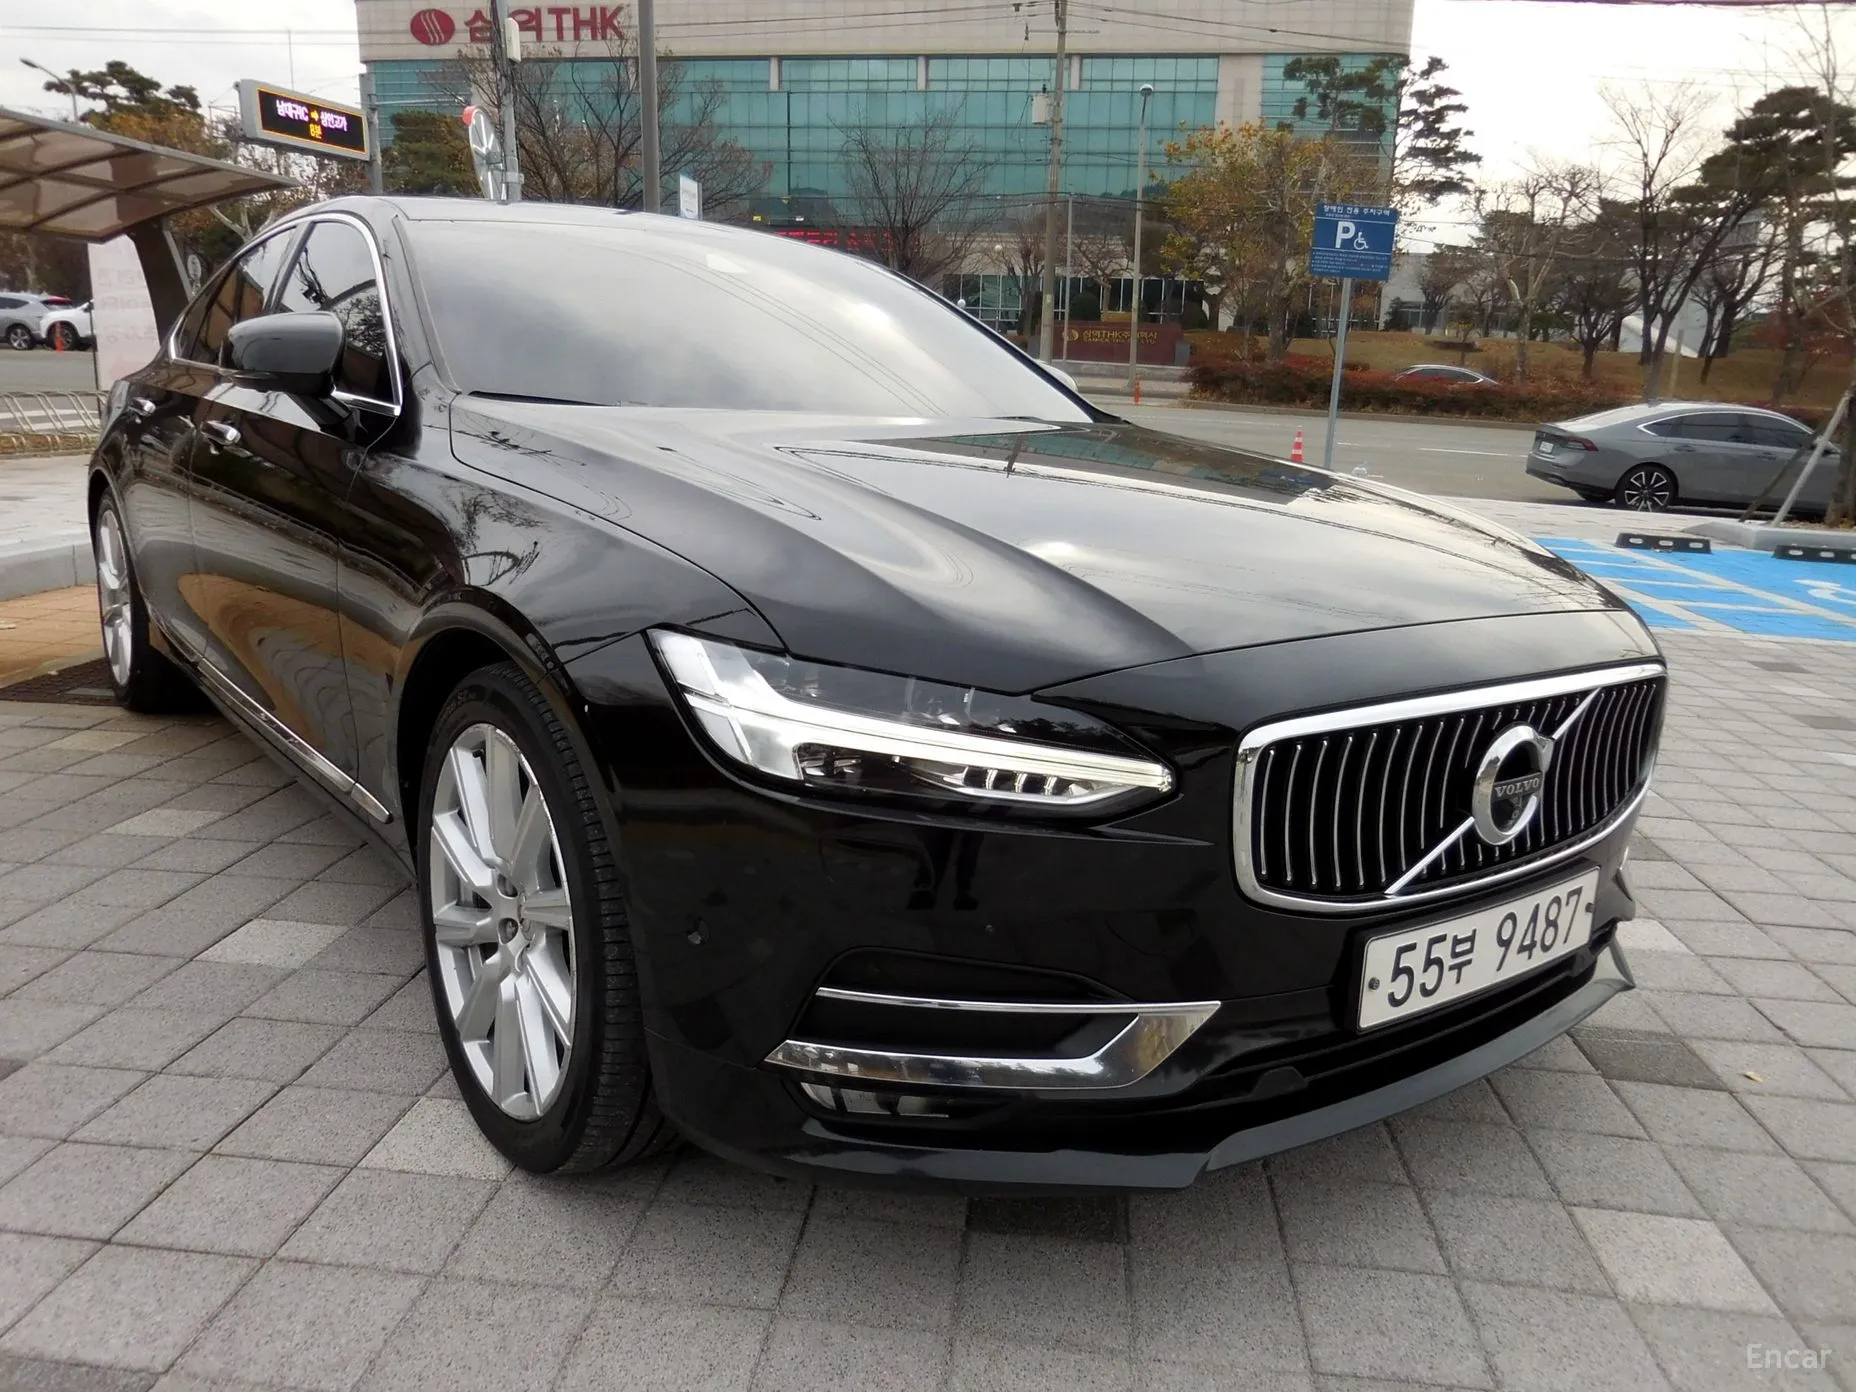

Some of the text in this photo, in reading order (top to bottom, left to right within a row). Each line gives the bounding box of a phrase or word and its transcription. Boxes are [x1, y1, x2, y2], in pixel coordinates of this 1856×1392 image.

[1323, 204, 1390, 217] 장애인 전용 주차구역
[1335, 221, 1356, 248] P
[1495, 778, 1540, 797] VOLVO
[1387, 886, 1583, 1007] 55부 9487
